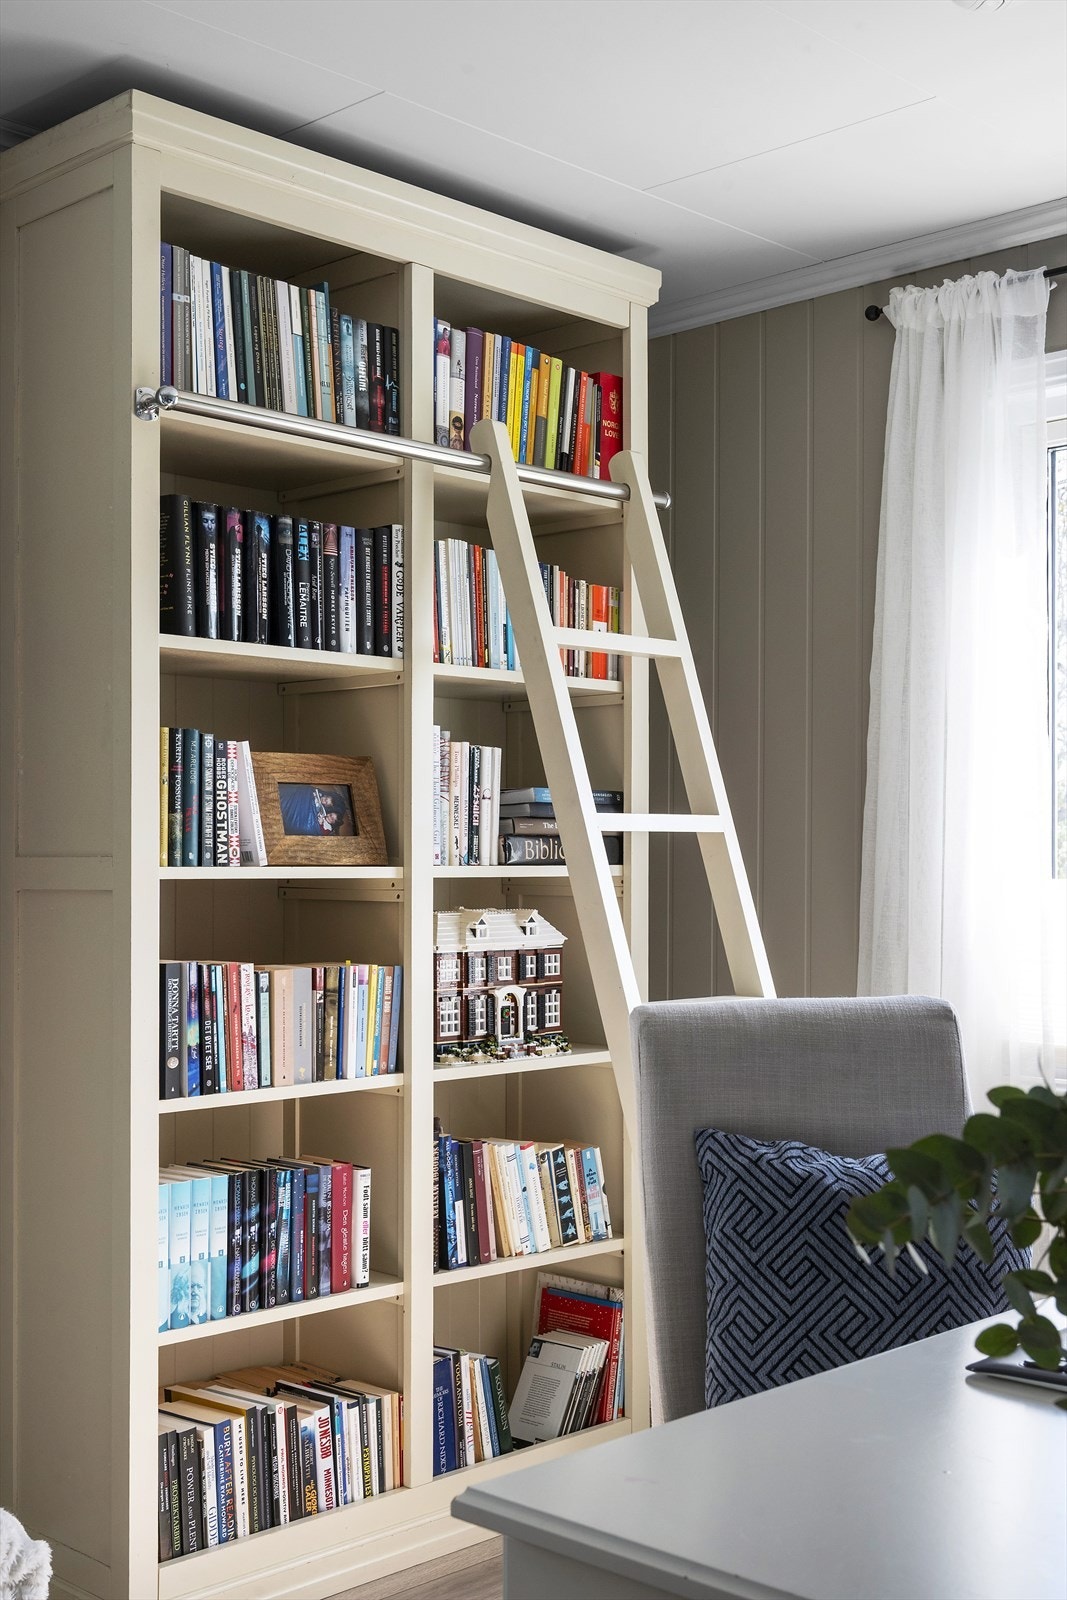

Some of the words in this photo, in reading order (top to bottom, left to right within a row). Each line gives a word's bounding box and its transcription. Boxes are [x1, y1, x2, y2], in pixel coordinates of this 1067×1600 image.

[359, 361, 367, 392] OFFLINE
[298, 524, 309, 561] ALEX
[396, 570, 404, 597] GODE
[299, 582, 307, 627] LEMAITRE
[440, 737, 449, 803] AUSCHWIT
[217, 780, 227, 864] GHOSTMAN
[384, 976, 392, 995] about
[340, 1228, 348, 1251] glemte
[551, 1362, 566, 1370] STALIN
[494, 1375, 508, 1430] KORANEN
[238, 1423, 242, 1434] WE
[318, 1417, 330, 1429] JO
[437, 1402, 446, 1444] RICHARD
[223, 1425, 231, 1457] BURN
[320, 1429, 332, 1459] NESBØ
[239, 1458, 244, 1467] TO
[363, 1448, 372, 1497] PSYKOPATTES
[439, 1447, 447, 1474] NIXON
[186, 1467, 195, 1504] POWER
[225, 1461, 233, 1496] AFTER
[324, 1468, 333, 1511] MINNESOTA
[171, 1479, 180, 1551] PROSJEKTARBEID
[208, 1507, 218, 1547] GIDDE
[226, 1498, 235, 1541] READIN
[189, 1520, 197, 1552] PLENT
